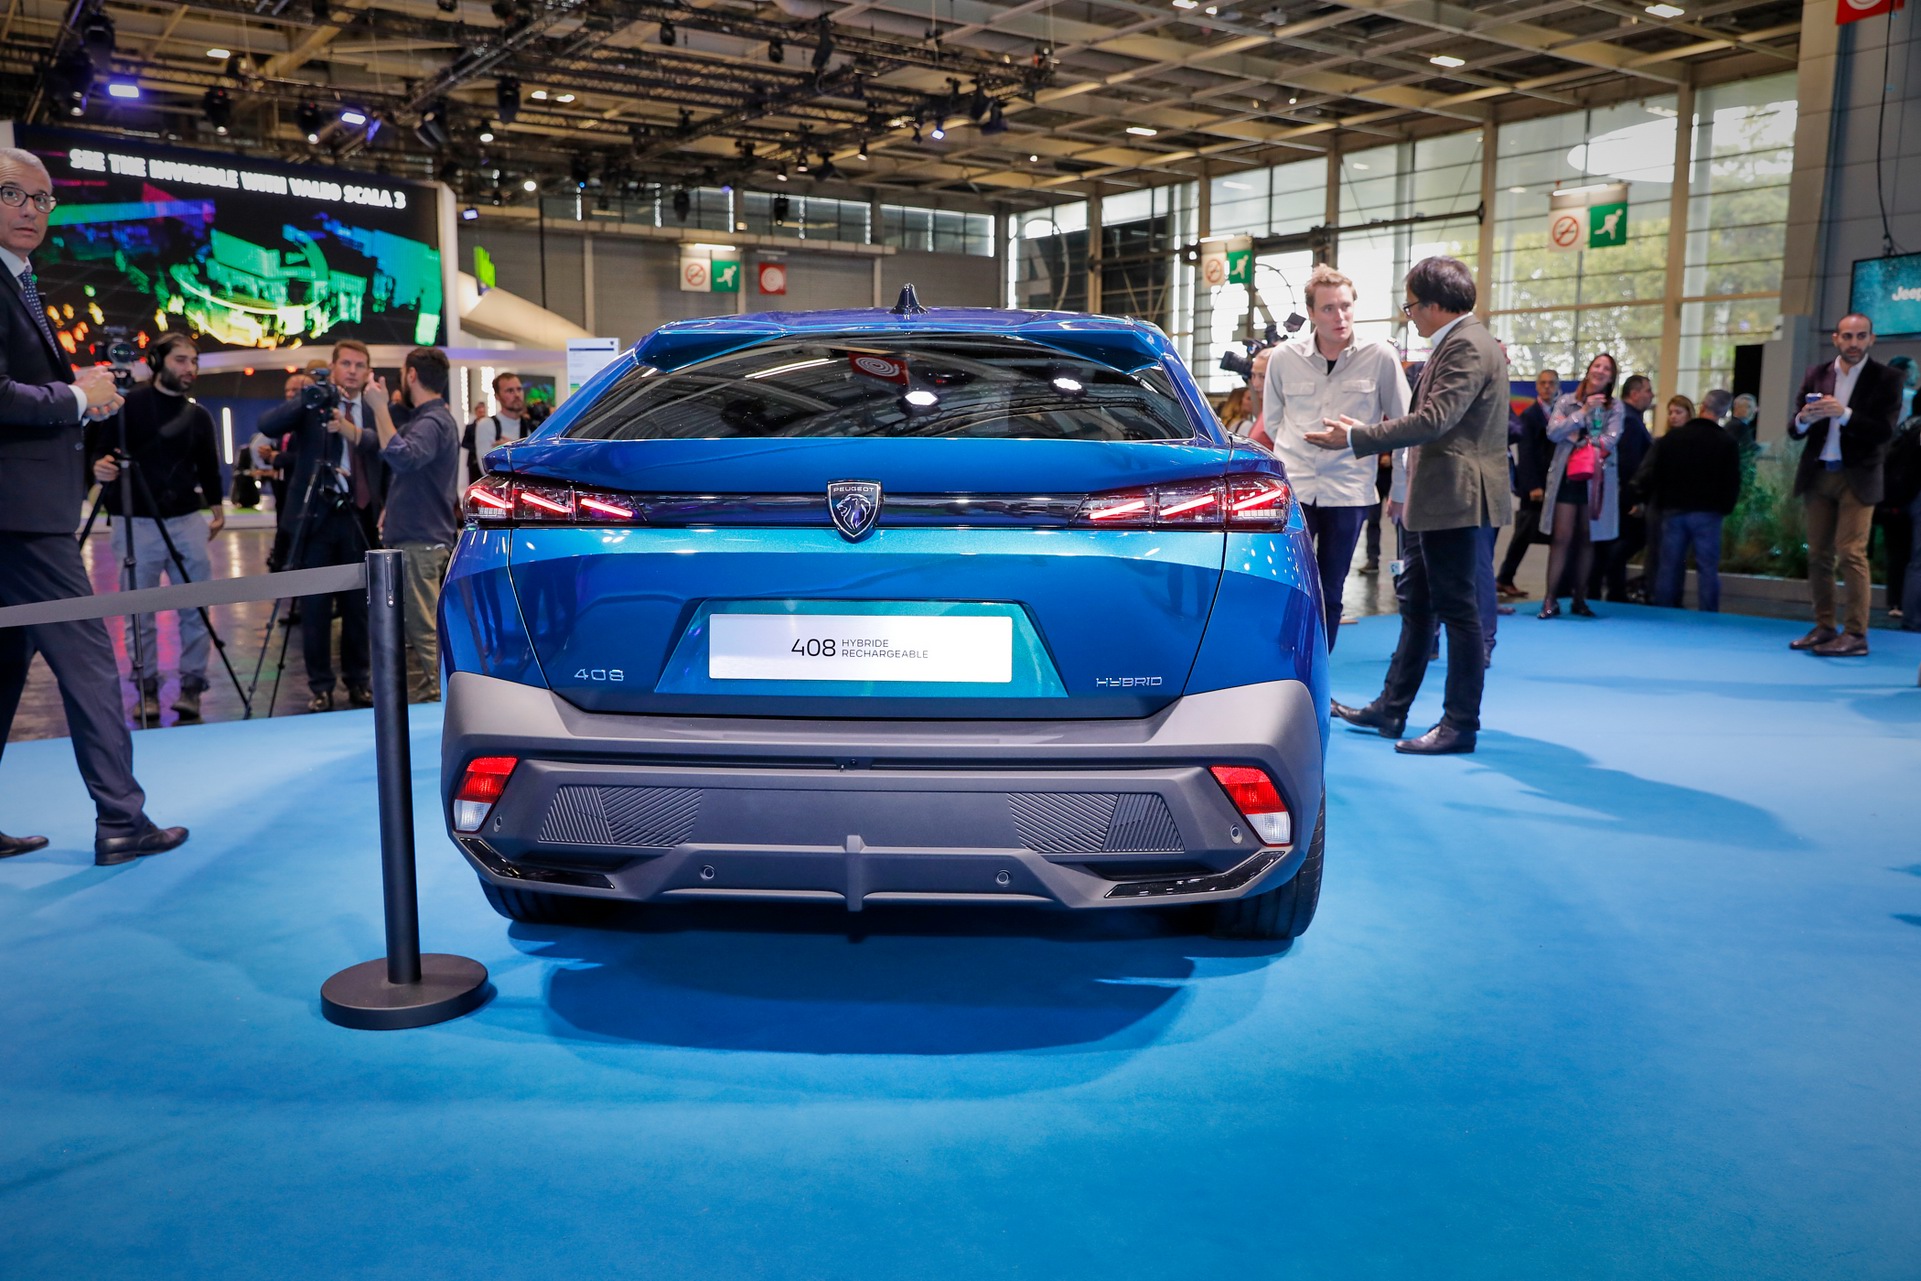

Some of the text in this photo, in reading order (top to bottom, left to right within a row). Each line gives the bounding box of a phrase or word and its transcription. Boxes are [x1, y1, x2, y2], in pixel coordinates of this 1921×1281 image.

[69, 148, 407, 209] SEE THE INVISIBLE WITH VALEO SCALA 3
[791, 638, 889, 657] 408 HYBRIDE
[841, 649, 929, 659] RECHARGEABLE
[573, 668, 624, 682] 408
[1096, 676, 1163, 687] HYBRID
